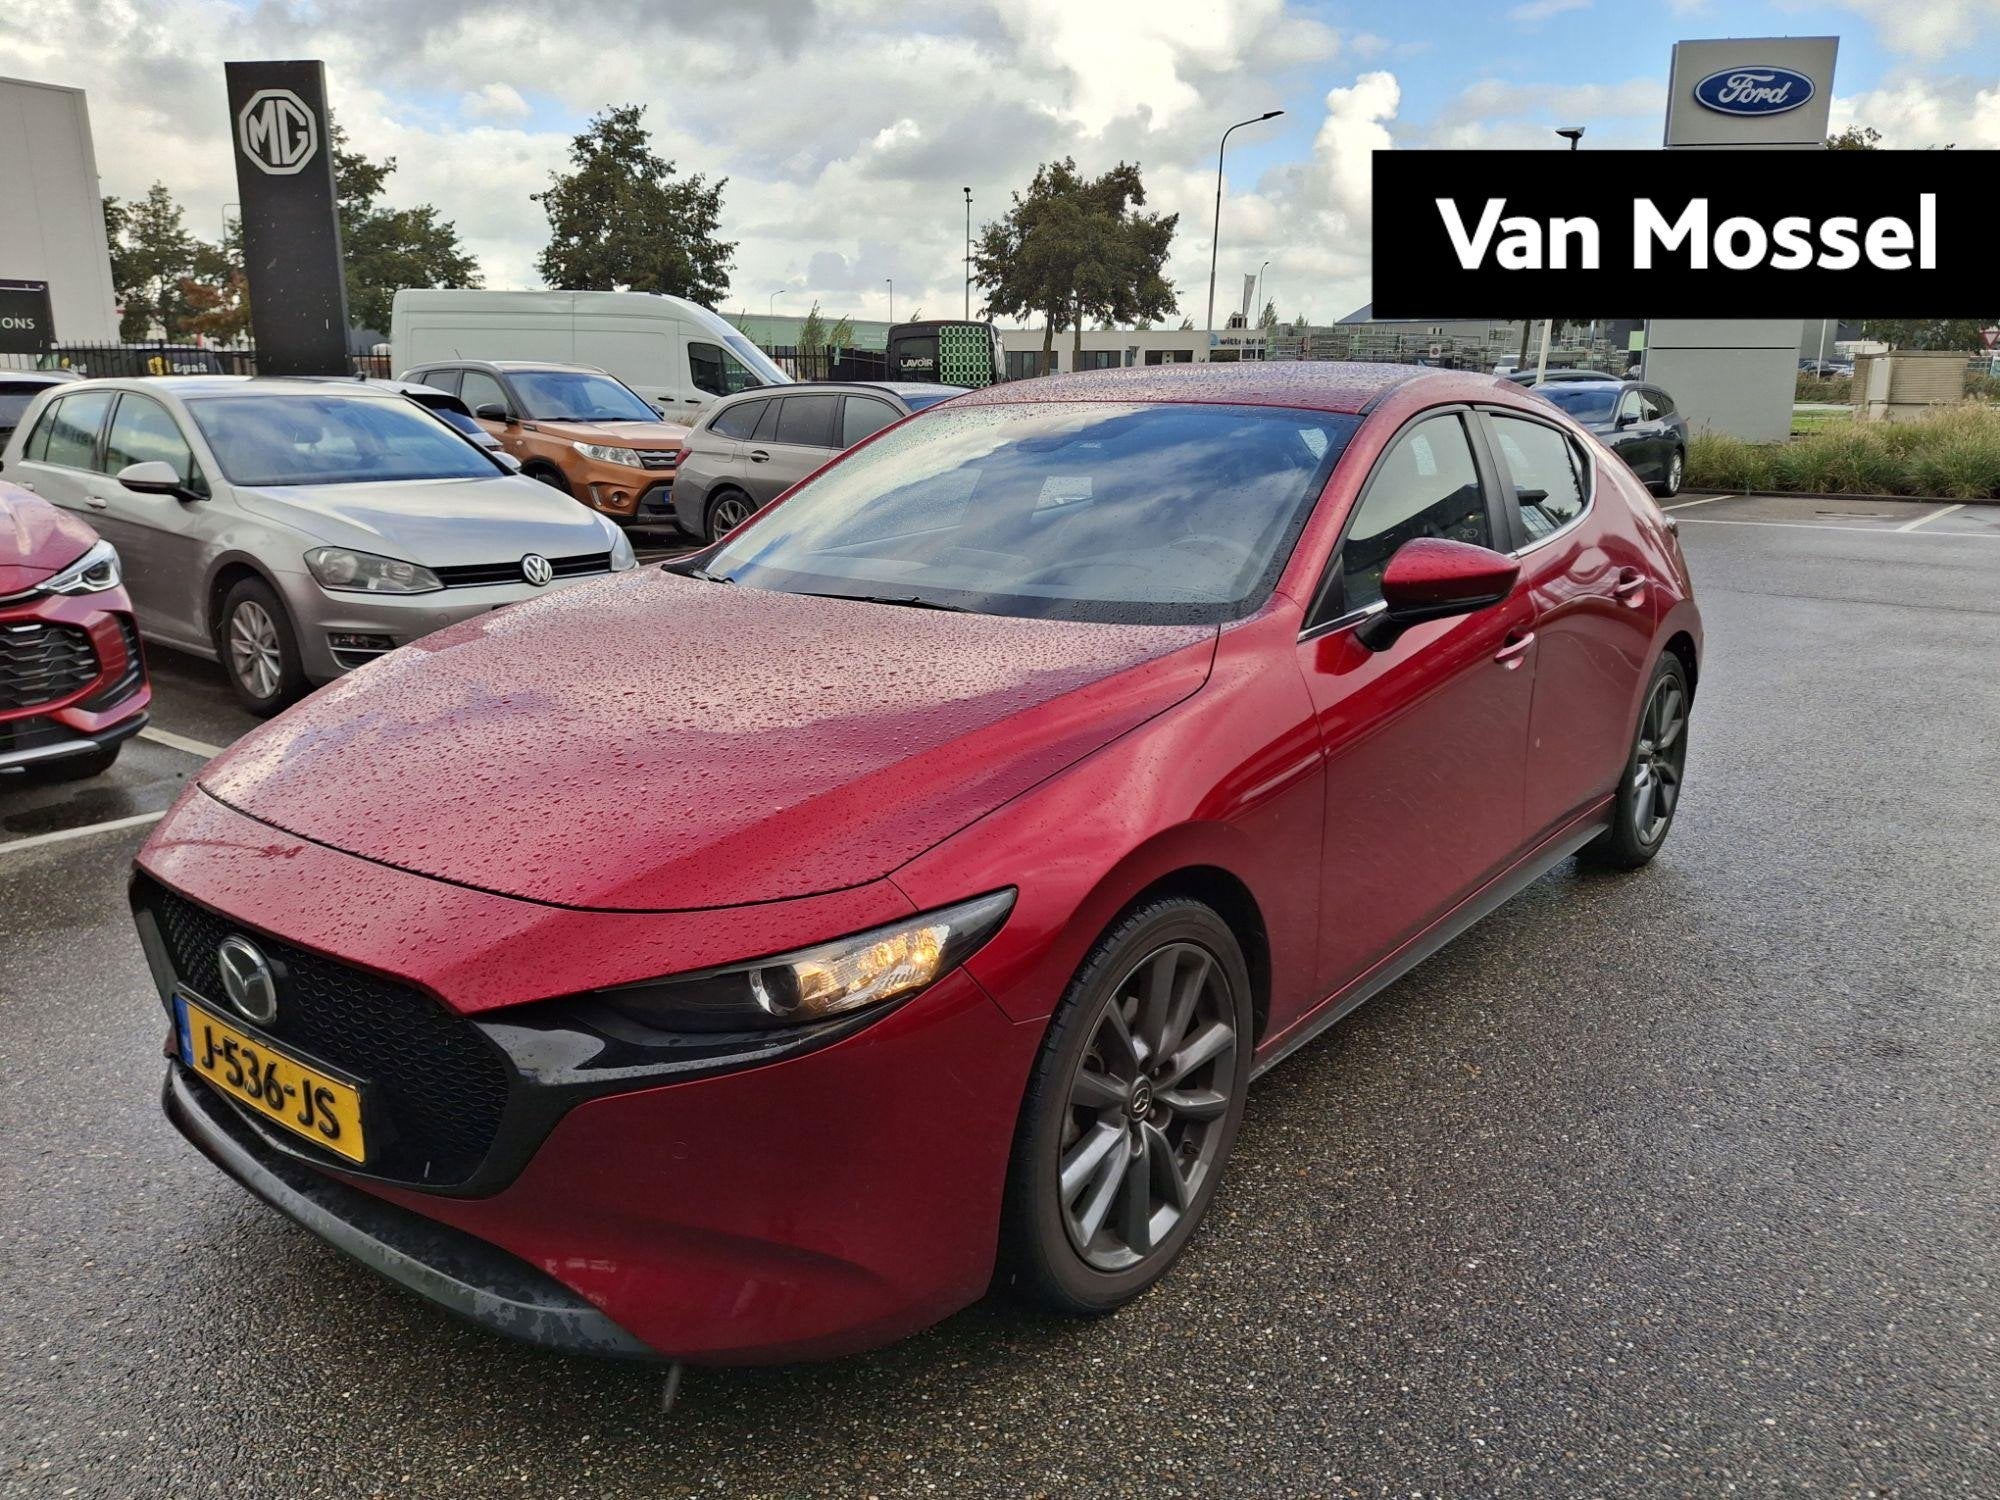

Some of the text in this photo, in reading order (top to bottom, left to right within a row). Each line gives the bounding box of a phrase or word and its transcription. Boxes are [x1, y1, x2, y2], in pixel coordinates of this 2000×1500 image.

[1718, 73, 1792, 104] Ford
[248, 99, 309, 165] MG
[0, 316, 36, 330] ONS
[202, 1025, 341, 1140] J-536-JS
